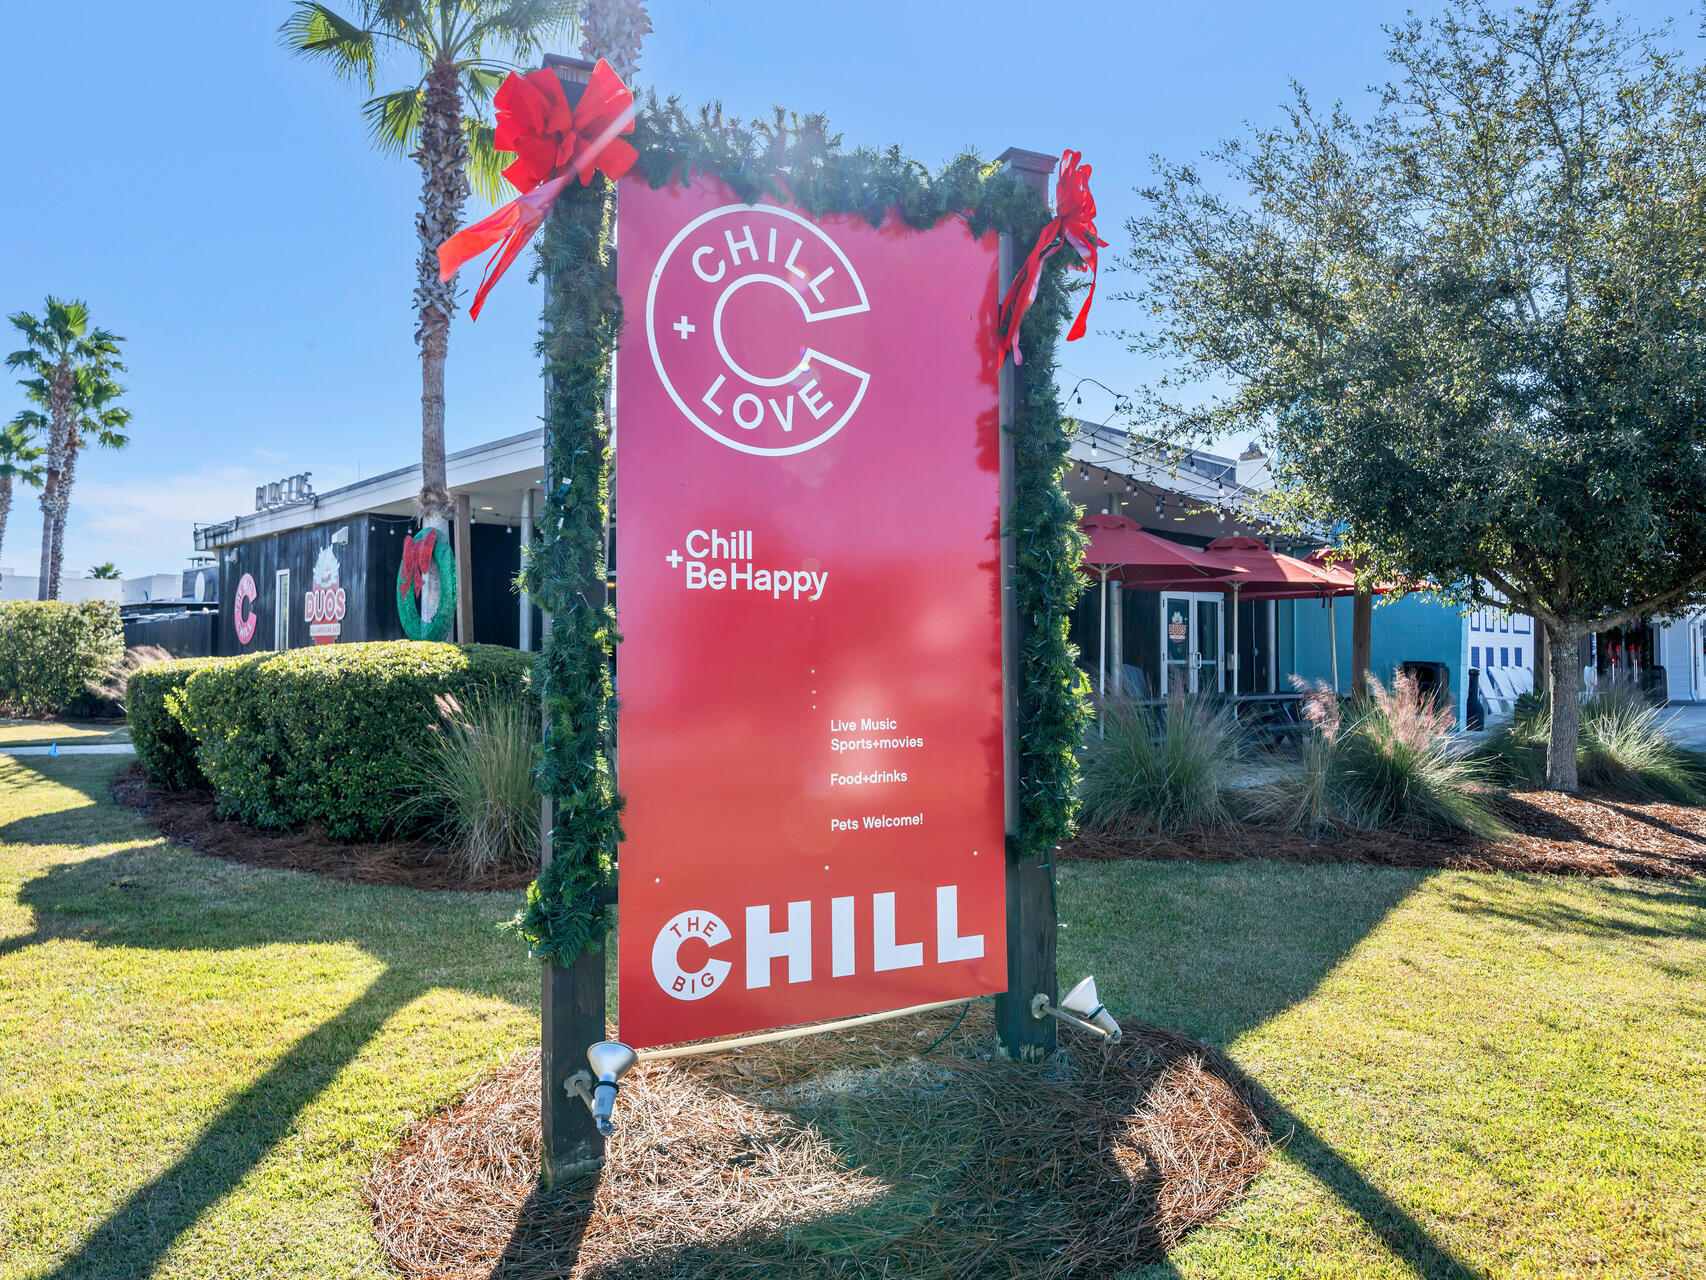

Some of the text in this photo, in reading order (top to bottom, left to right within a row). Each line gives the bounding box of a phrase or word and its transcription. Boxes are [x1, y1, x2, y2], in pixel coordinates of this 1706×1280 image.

[692, 225, 835, 304] CHILL
[701, 374, 834, 432] LOVE
[685, 529, 753, 560] Chill
[304, 587, 346, 622] DUOS
[830, 717, 898, 732] Live Music
[830, 736, 924, 754] Sports+movies
[830, 769, 908, 786] Food+drinks
[830, 812, 923, 831] Pets Welcome!
[669, 916, 718, 938] THE
[671, 972, 715, 994] BIG
